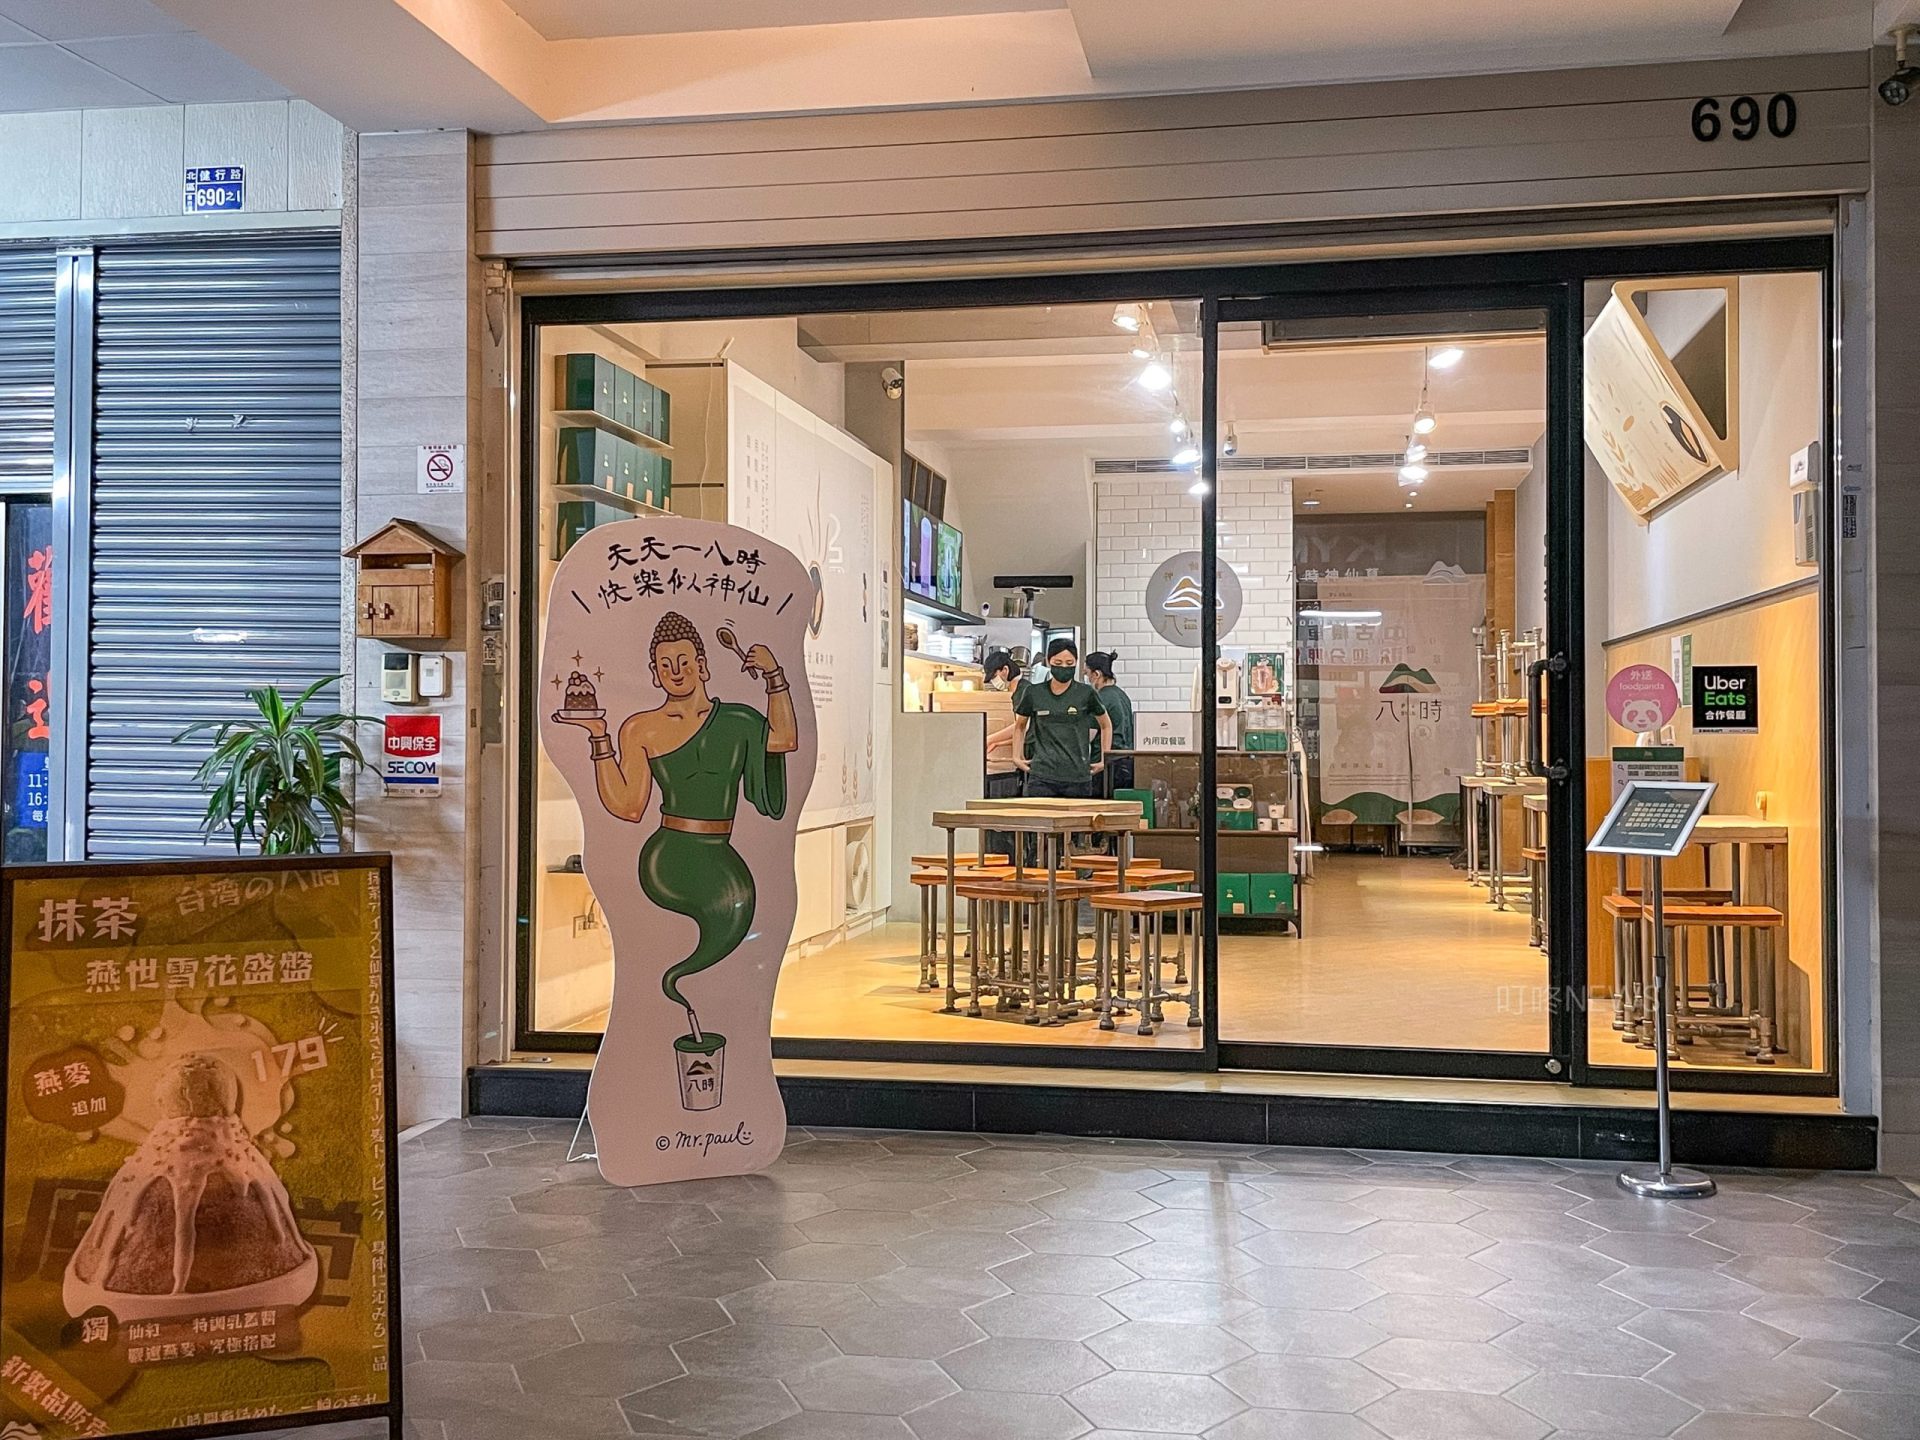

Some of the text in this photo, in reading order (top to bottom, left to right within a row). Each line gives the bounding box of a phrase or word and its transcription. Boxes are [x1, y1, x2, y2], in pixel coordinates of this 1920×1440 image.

[1692, 93, 1796, 141] 690
[607, 536, 767, 575] 天天一八時
[598, 567, 770, 609] 快樂似神仙
[1619, 682, 1665, 691] foodpanda
[1704, 675, 1747, 690] Uber
[1704, 691, 1747, 706] Eats
[387, 736, 437, 751] 中興保全
[387, 761, 436, 775] SECOM
[38, 897, 140, 942] 抹茶
[85, 950, 314, 994] 燕世雪花盛盤
[251, 1034, 328, 1082] 179
[34, 1061, 91, 1097] 燕麥
[686, 1077, 715, 1093] 八時
[72, 1096, 106, 1117] 追加
